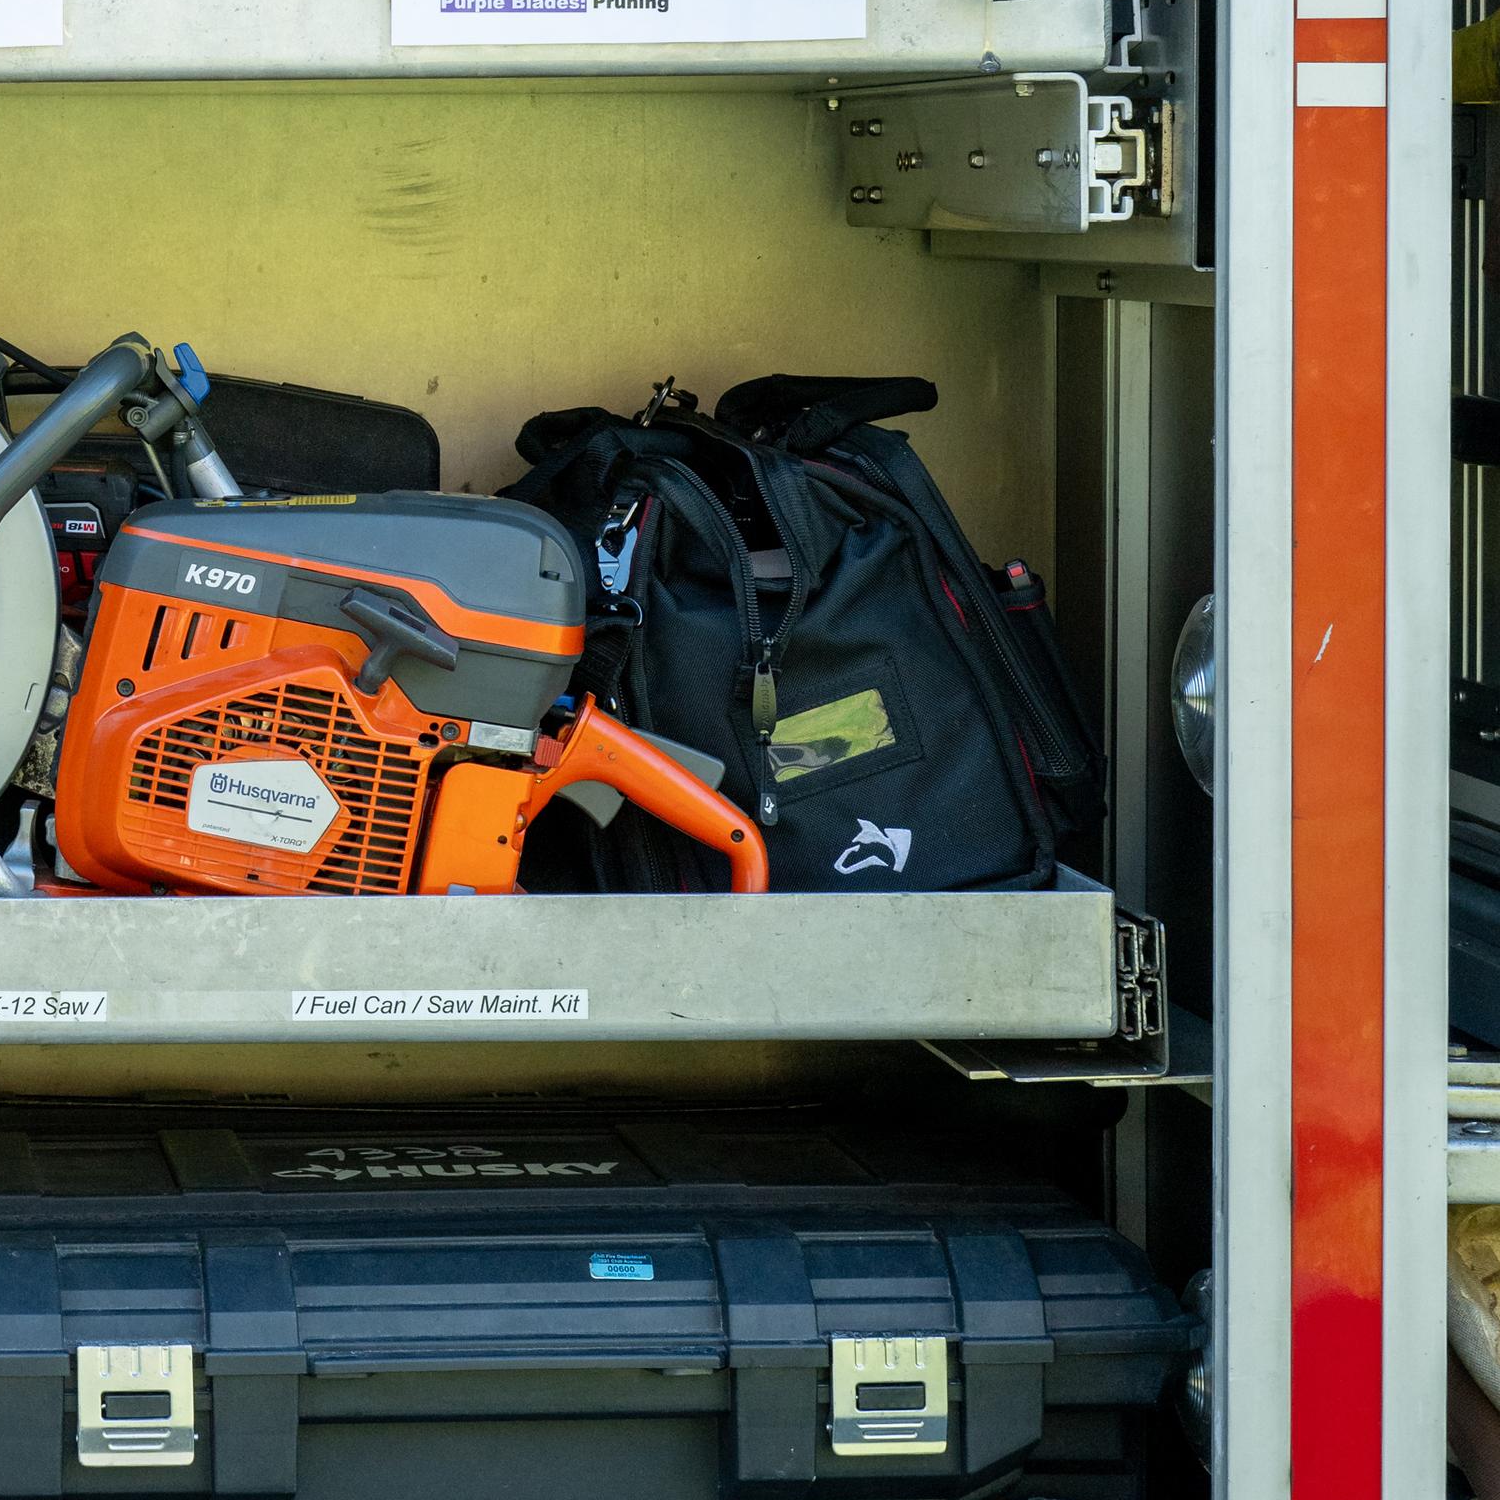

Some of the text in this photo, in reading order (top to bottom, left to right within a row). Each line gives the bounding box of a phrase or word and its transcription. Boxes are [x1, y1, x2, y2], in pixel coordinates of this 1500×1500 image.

[228, 778, 316, 809] Husqvarna
[43, 996, 89, 1015] Saw
[310, 996, 357, 1015] Fuel
[364, 995, 406, 1014] Can
[427, 995, 474, 1014] Saw
[480, 995, 542, 1014] Maint.
[551, 994, 580, 1013] Kit
[365, 1161, 620, 1179] HUSKY
